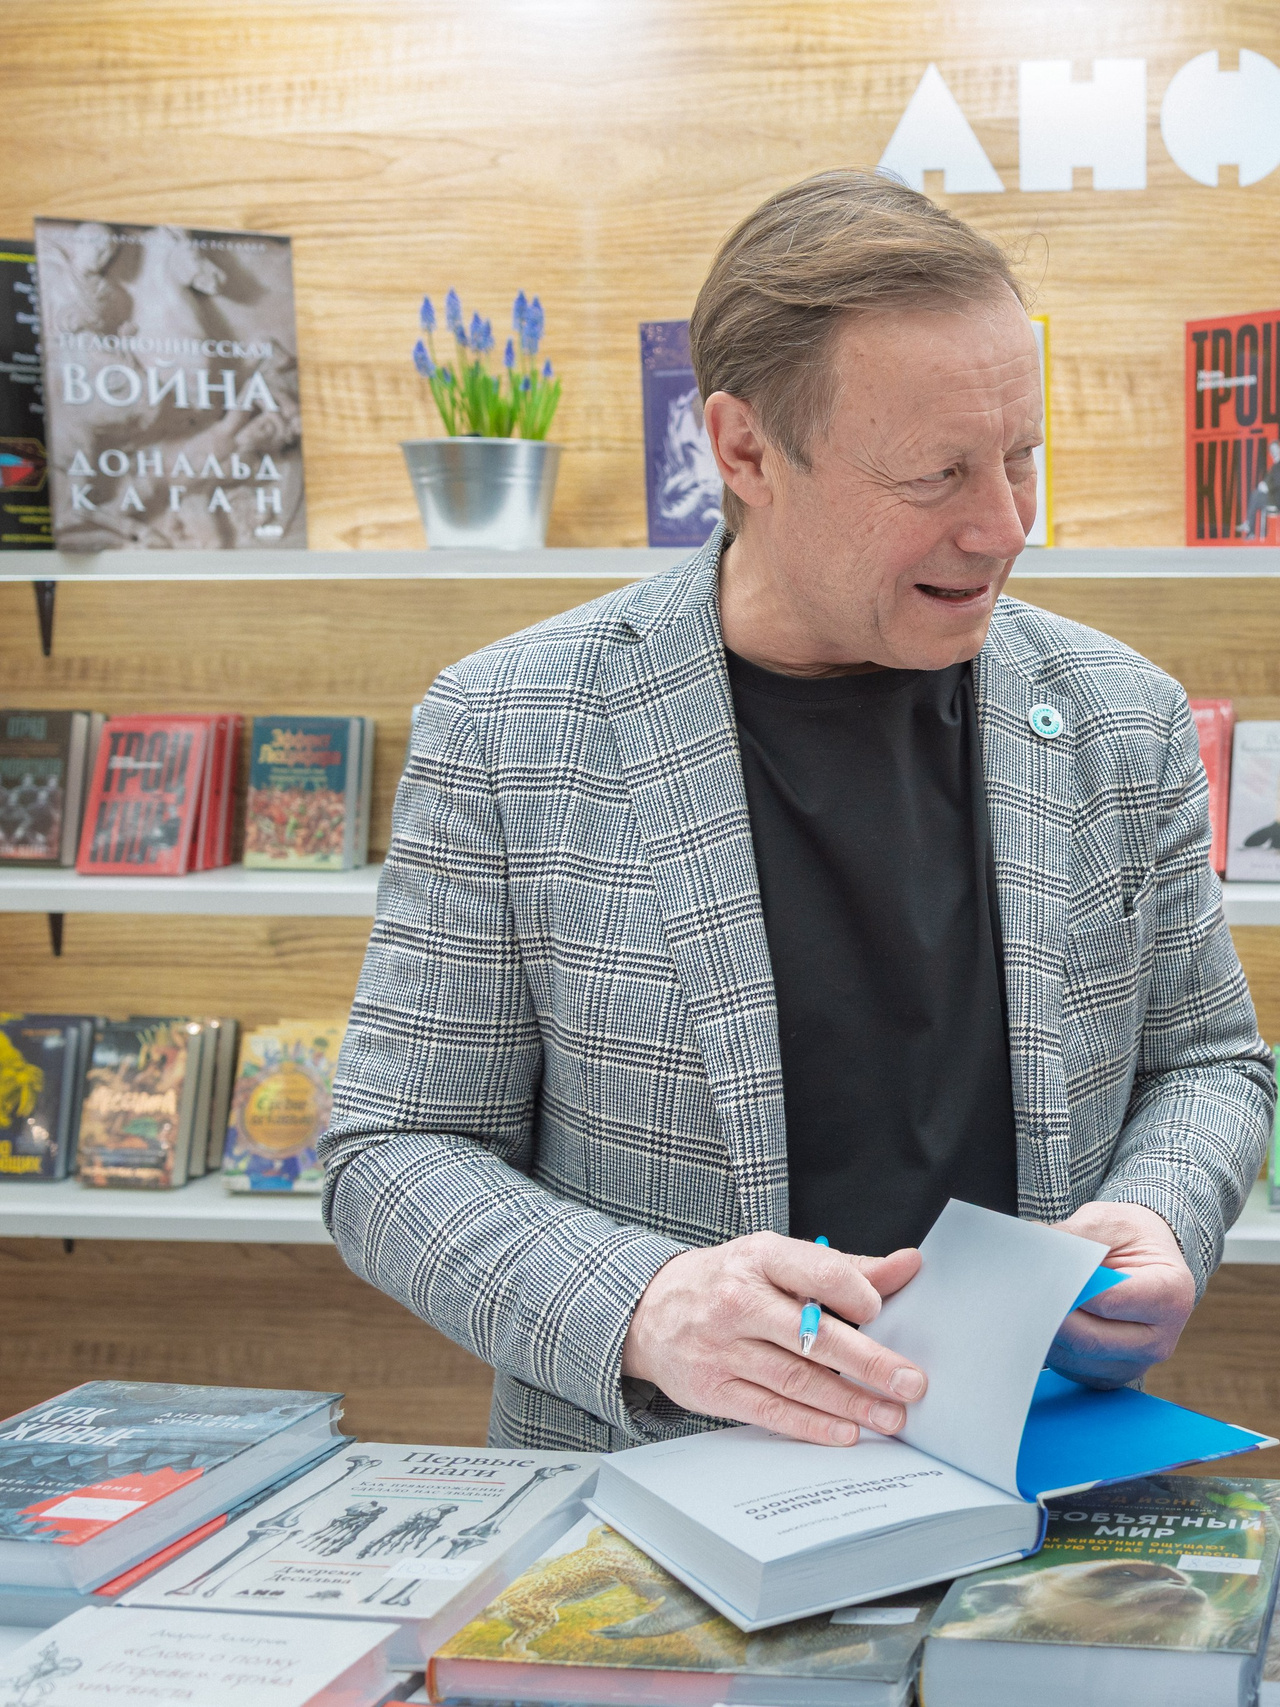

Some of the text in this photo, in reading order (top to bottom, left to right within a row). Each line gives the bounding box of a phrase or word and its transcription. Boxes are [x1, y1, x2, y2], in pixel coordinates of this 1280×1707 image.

[62, 357, 280, 412] ВОЙНА
[67, 448, 282, 481] ДОНАЛЬД
[1195, 428, 1269, 540] КИЙ
[70, 483, 282, 514] КАГАН
[27, 1405, 119, 1425] КАК
[0, 1423, 147, 1447] ЖИВЫЕ
[400, 1452, 536, 1469] Первые
[406, 1466, 499, 1478] шаги
[0, 1486, 73, 1498] ЕЗНУВШИЕ
[745, 1470, 943, 1515] бессознательного
[754, 1482, 914, 1521] Тайны нашего
[1047, 1510, 1262, 1531] ЕОБЪЯТНЫЙ
[1094, 1525, 1176, 1540] МИР
[1065, 1538, 1145, 1547] ЖИВОТНЫЕ
[1150, 1542, 1227, 1551] ОЩУЩАЮТ
[1148, 1548, 1240, 1559] РЕАЛЬНОСТЬ
[264, 1573, 352, 1584] Десильва
[274, 1566, 363, 1577] Джереми
